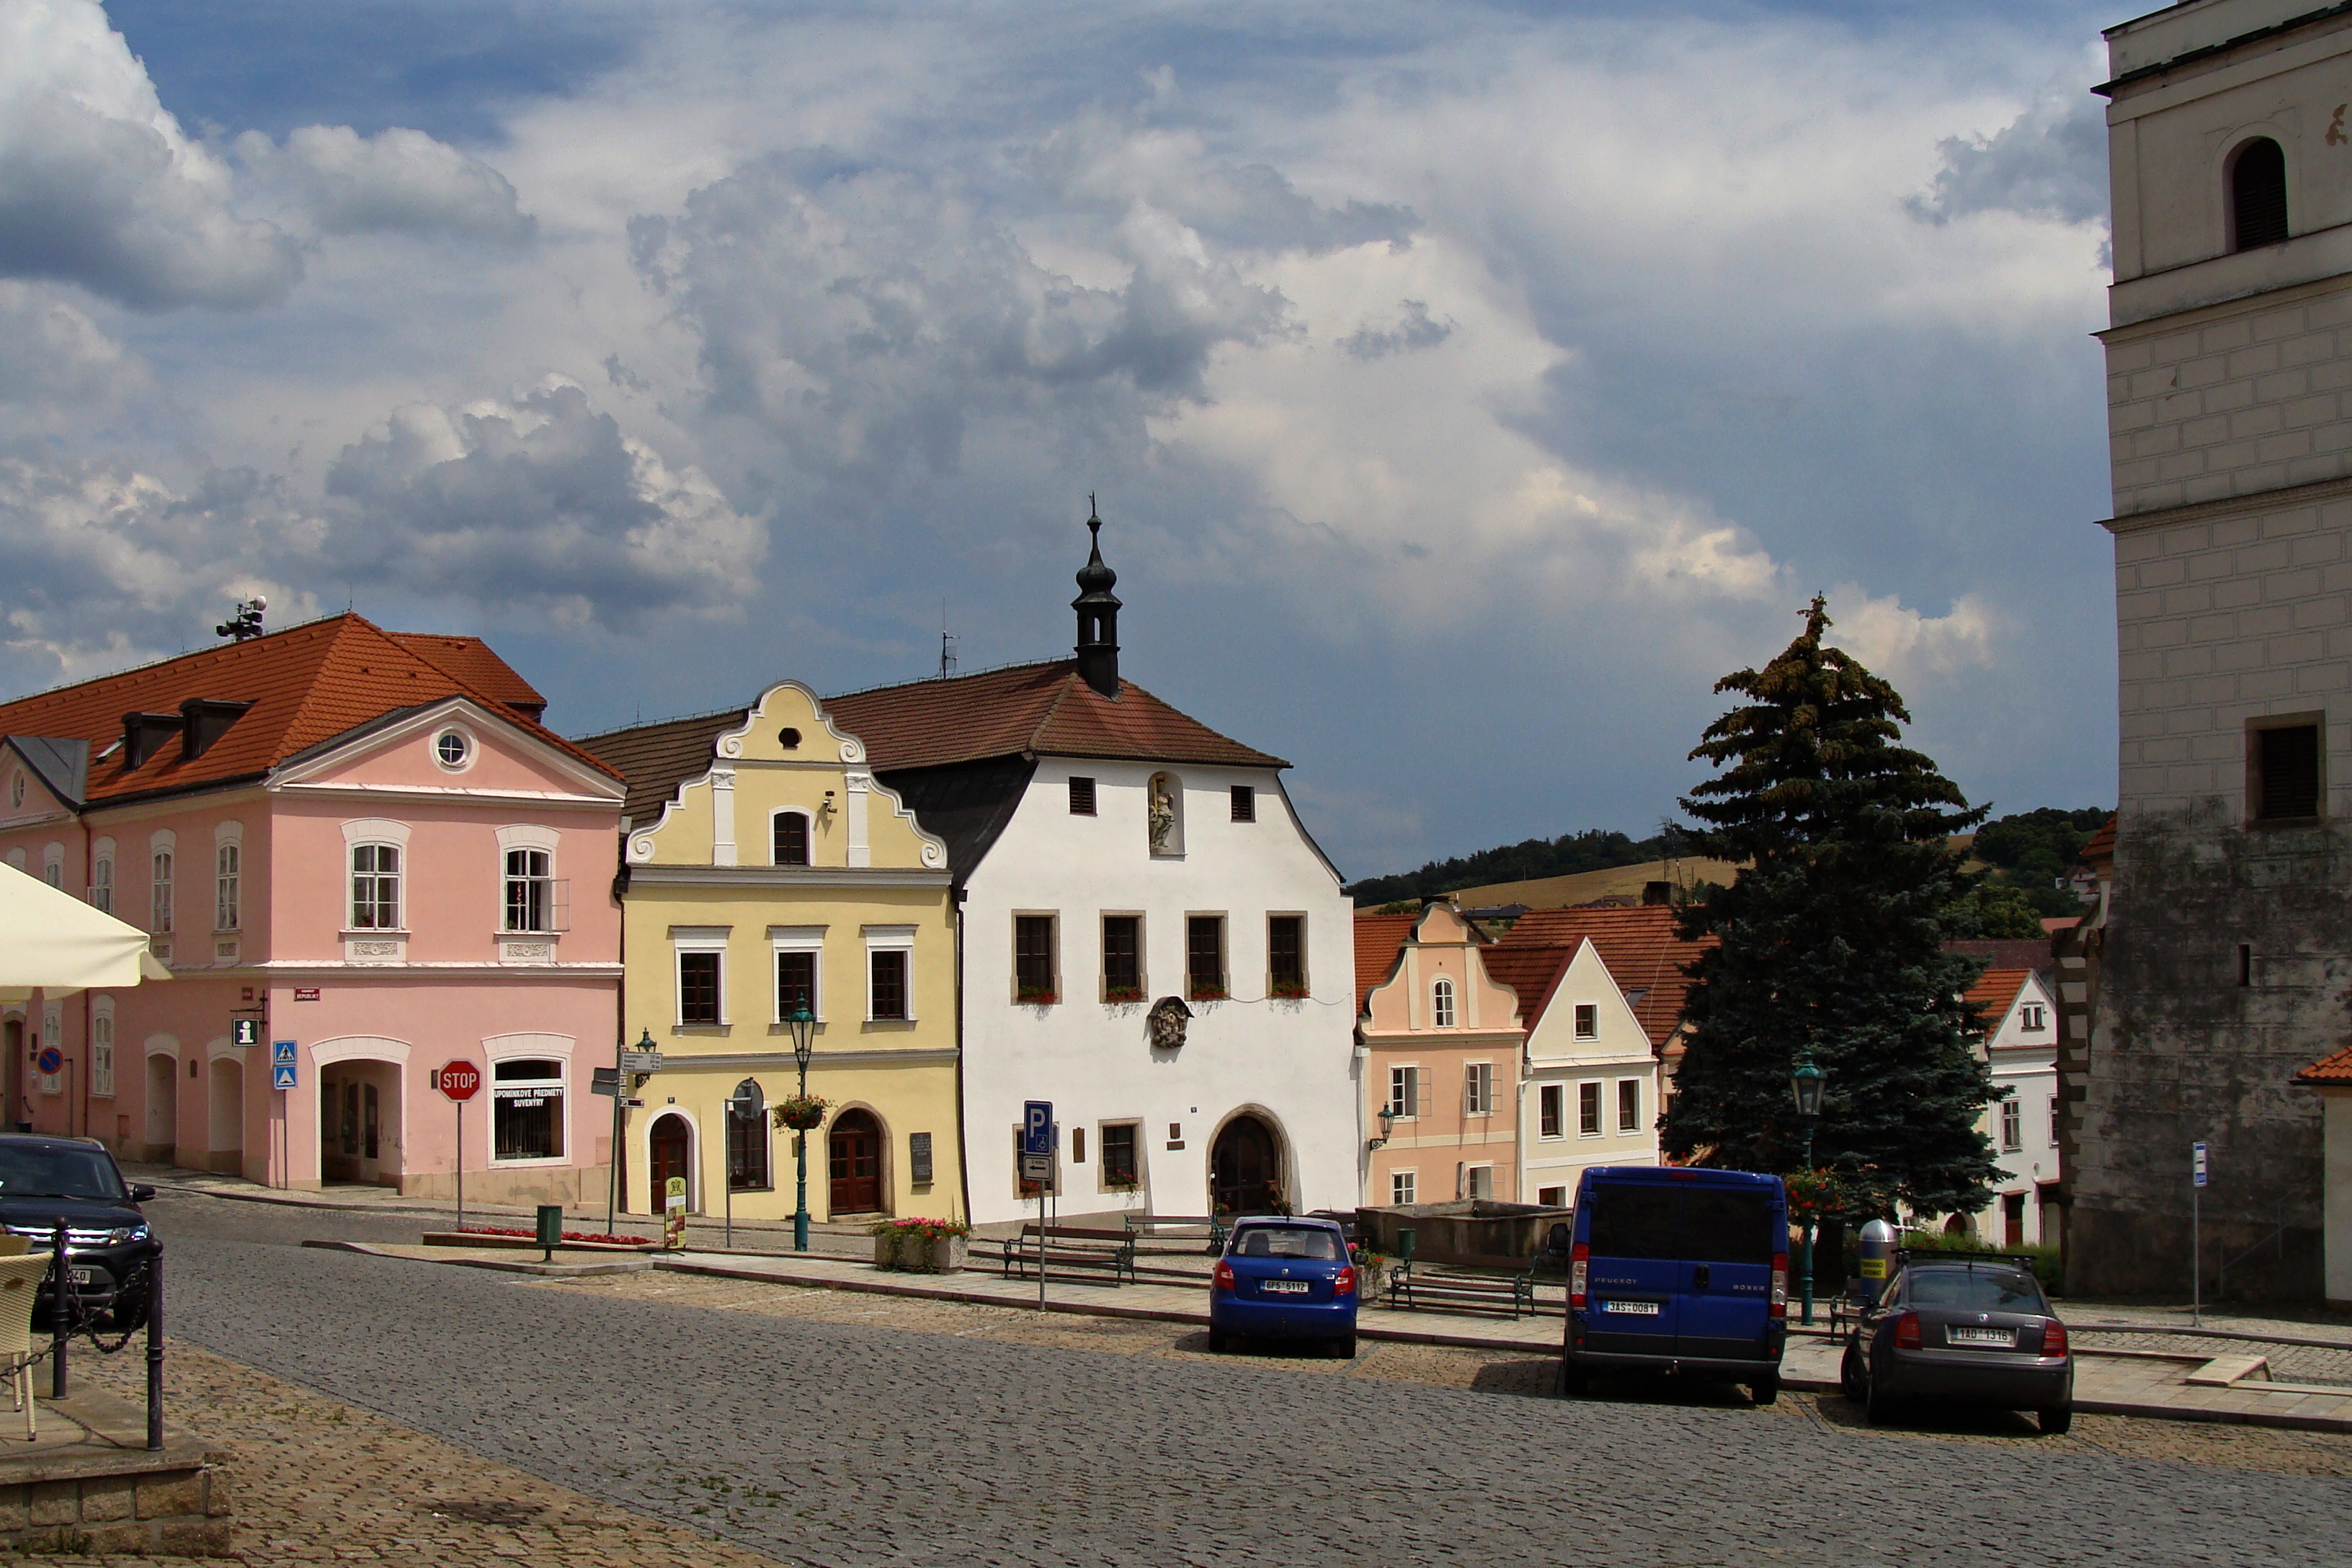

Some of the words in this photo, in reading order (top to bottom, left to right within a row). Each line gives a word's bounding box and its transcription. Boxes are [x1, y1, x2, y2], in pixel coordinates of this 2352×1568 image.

[443, 1073, 476, 1089] STOP
[1030, 1108, 1046, 1138] P
[1286, 1283, 1305, 1291] 5112
[1610, 1302, 1626, 1311] 3AS
[1632, 1304, 1654, 1313] 0081
[1960, 1329, 1977, 1339] 1AD
[1985, 1330, 2008, 1340] 1316
